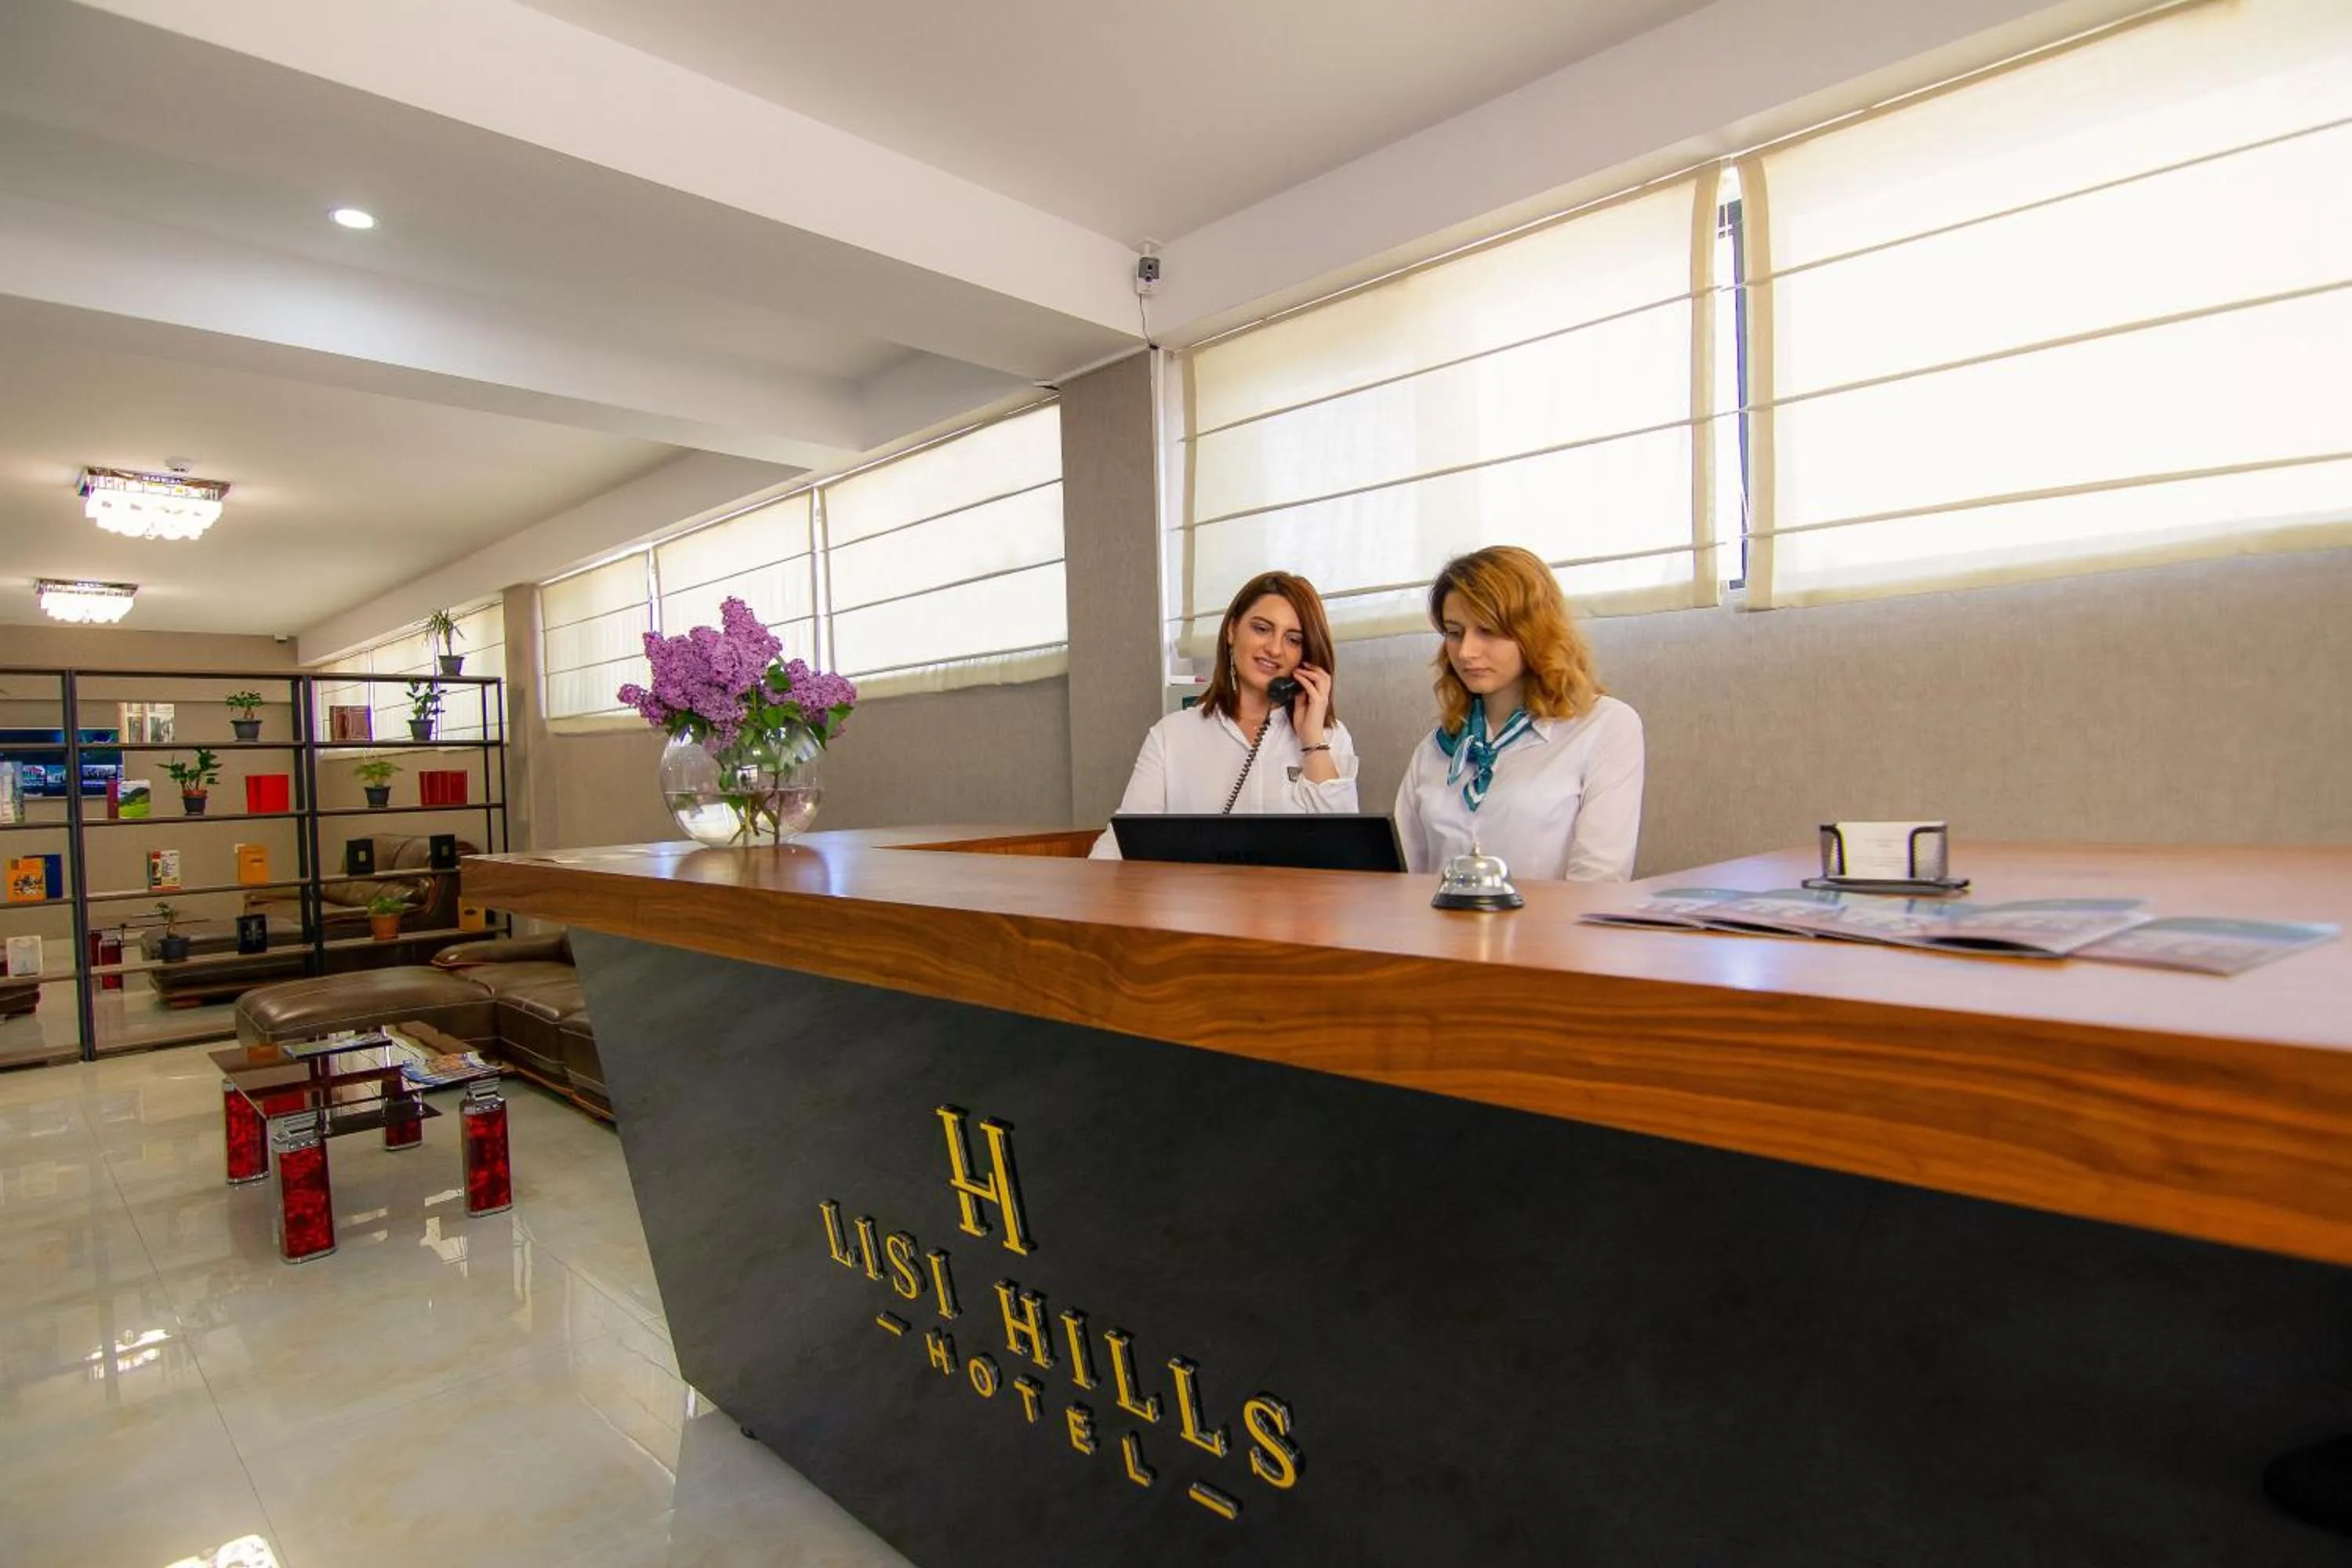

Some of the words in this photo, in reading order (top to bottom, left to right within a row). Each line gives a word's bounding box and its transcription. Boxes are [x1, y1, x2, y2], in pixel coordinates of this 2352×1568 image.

[821, 1200, 957, 1319] LISI
[995, 1281, 1302, 1490] HILLS
[926, 1330, 1152, 1487] HOTEL
